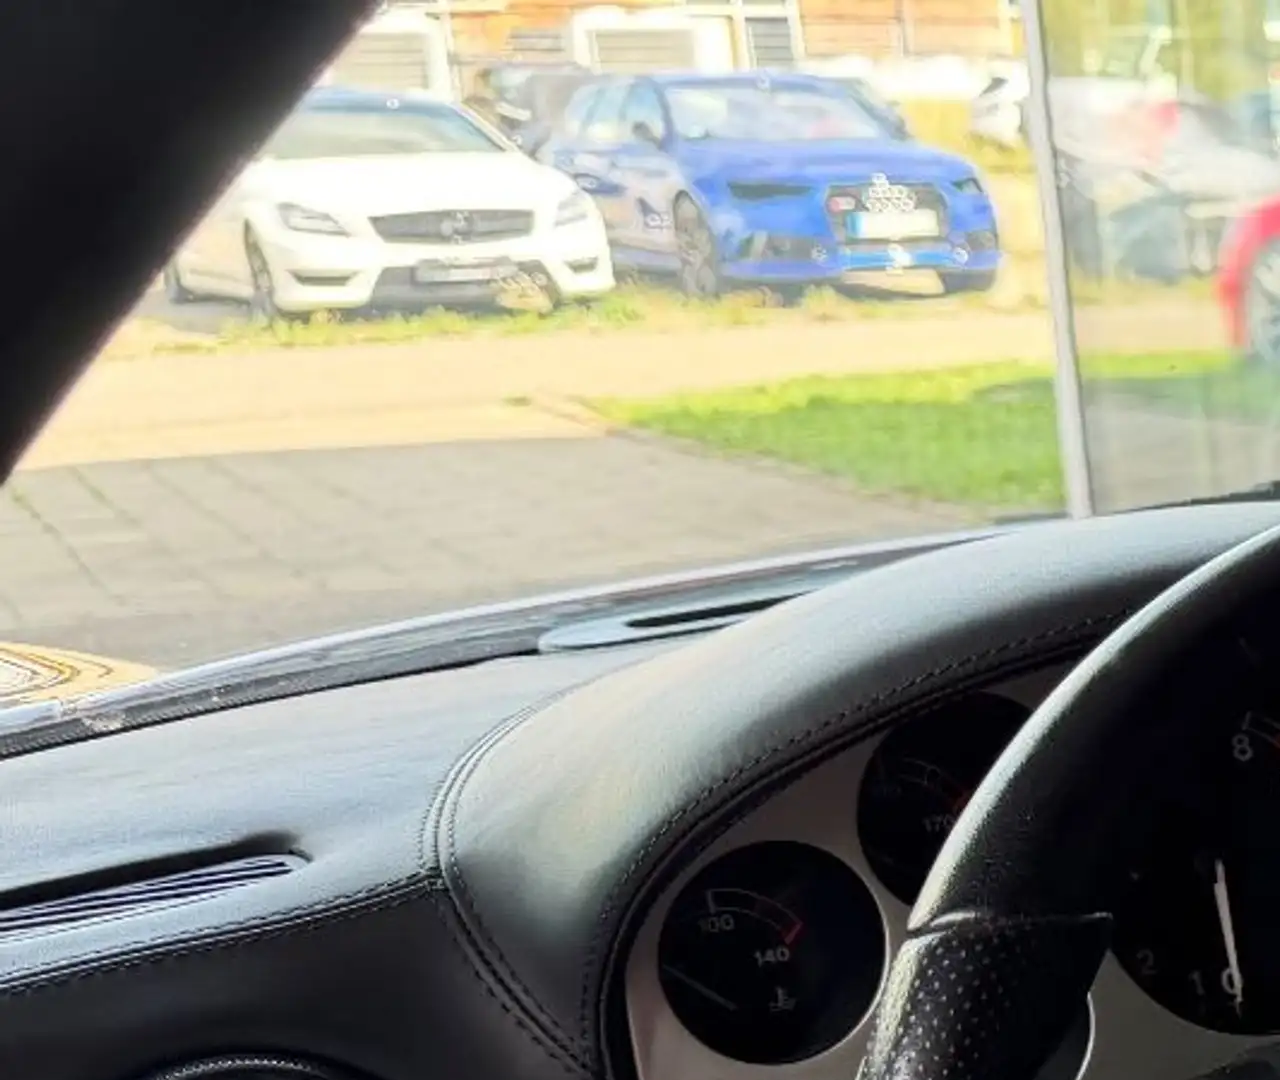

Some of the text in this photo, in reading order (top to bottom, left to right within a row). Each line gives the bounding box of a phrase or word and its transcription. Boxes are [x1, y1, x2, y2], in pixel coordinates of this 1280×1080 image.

[1230, 732, 1254, 763] 8
[696, 912, 736, 935] 100
[753, 944, 790, 968] 140
[1135, 947, 1159, 975] 2
[1187, 968, 1206, 997] 1
